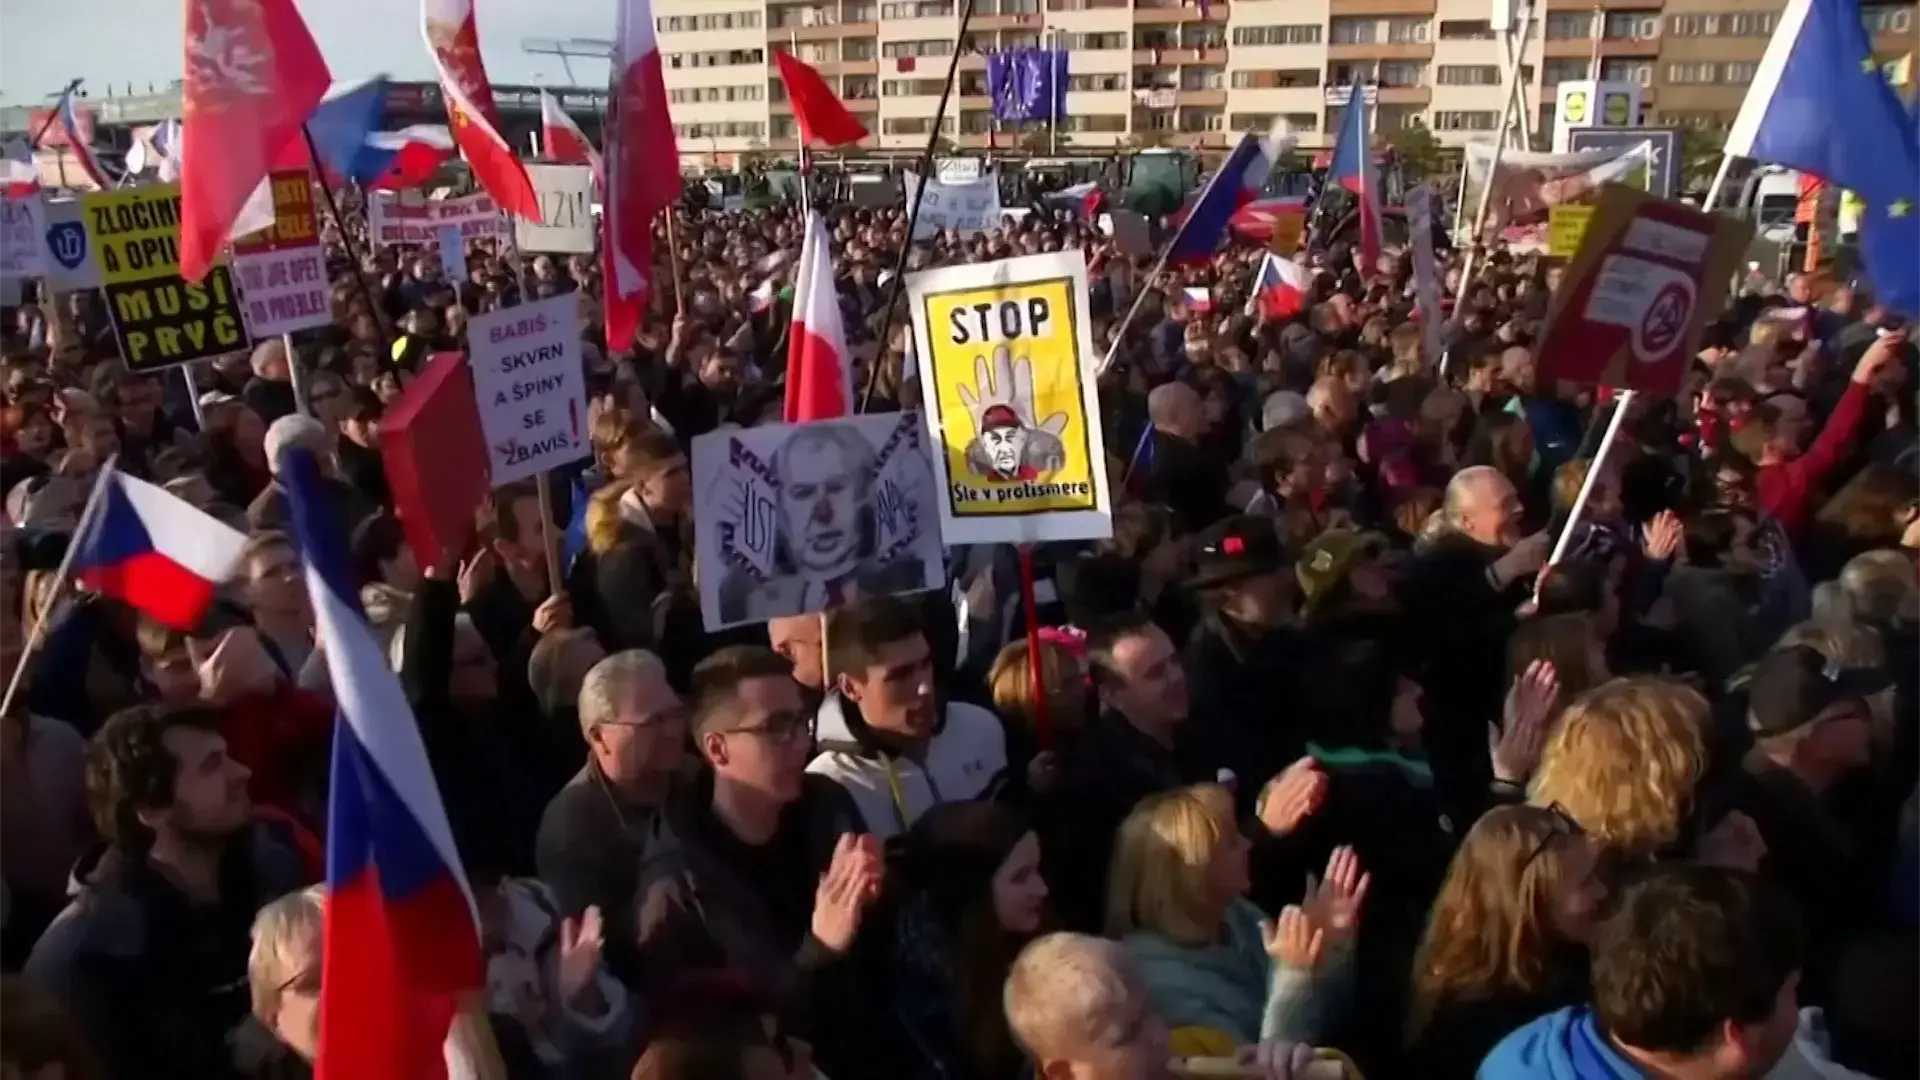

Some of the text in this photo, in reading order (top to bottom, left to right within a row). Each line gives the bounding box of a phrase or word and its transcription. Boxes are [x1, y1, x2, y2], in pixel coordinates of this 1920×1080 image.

[104, 243, 120, 272] A
[126, 235, 180, 271] OPIL
[115, 270, 229, 324] MUSÍ
[127, 309, 239, 363] PRYČ
[490, 311, 547, 344] BABIŠ
[950, 297, 1049, 344] STOP
[501, 341, 564, 374] SKVRN
[494, 390, 508, 408] A
[523, 409, 546, 430] SE
[982, 487, 991, 500] v
[996, 480, 1089, 504] protismere
